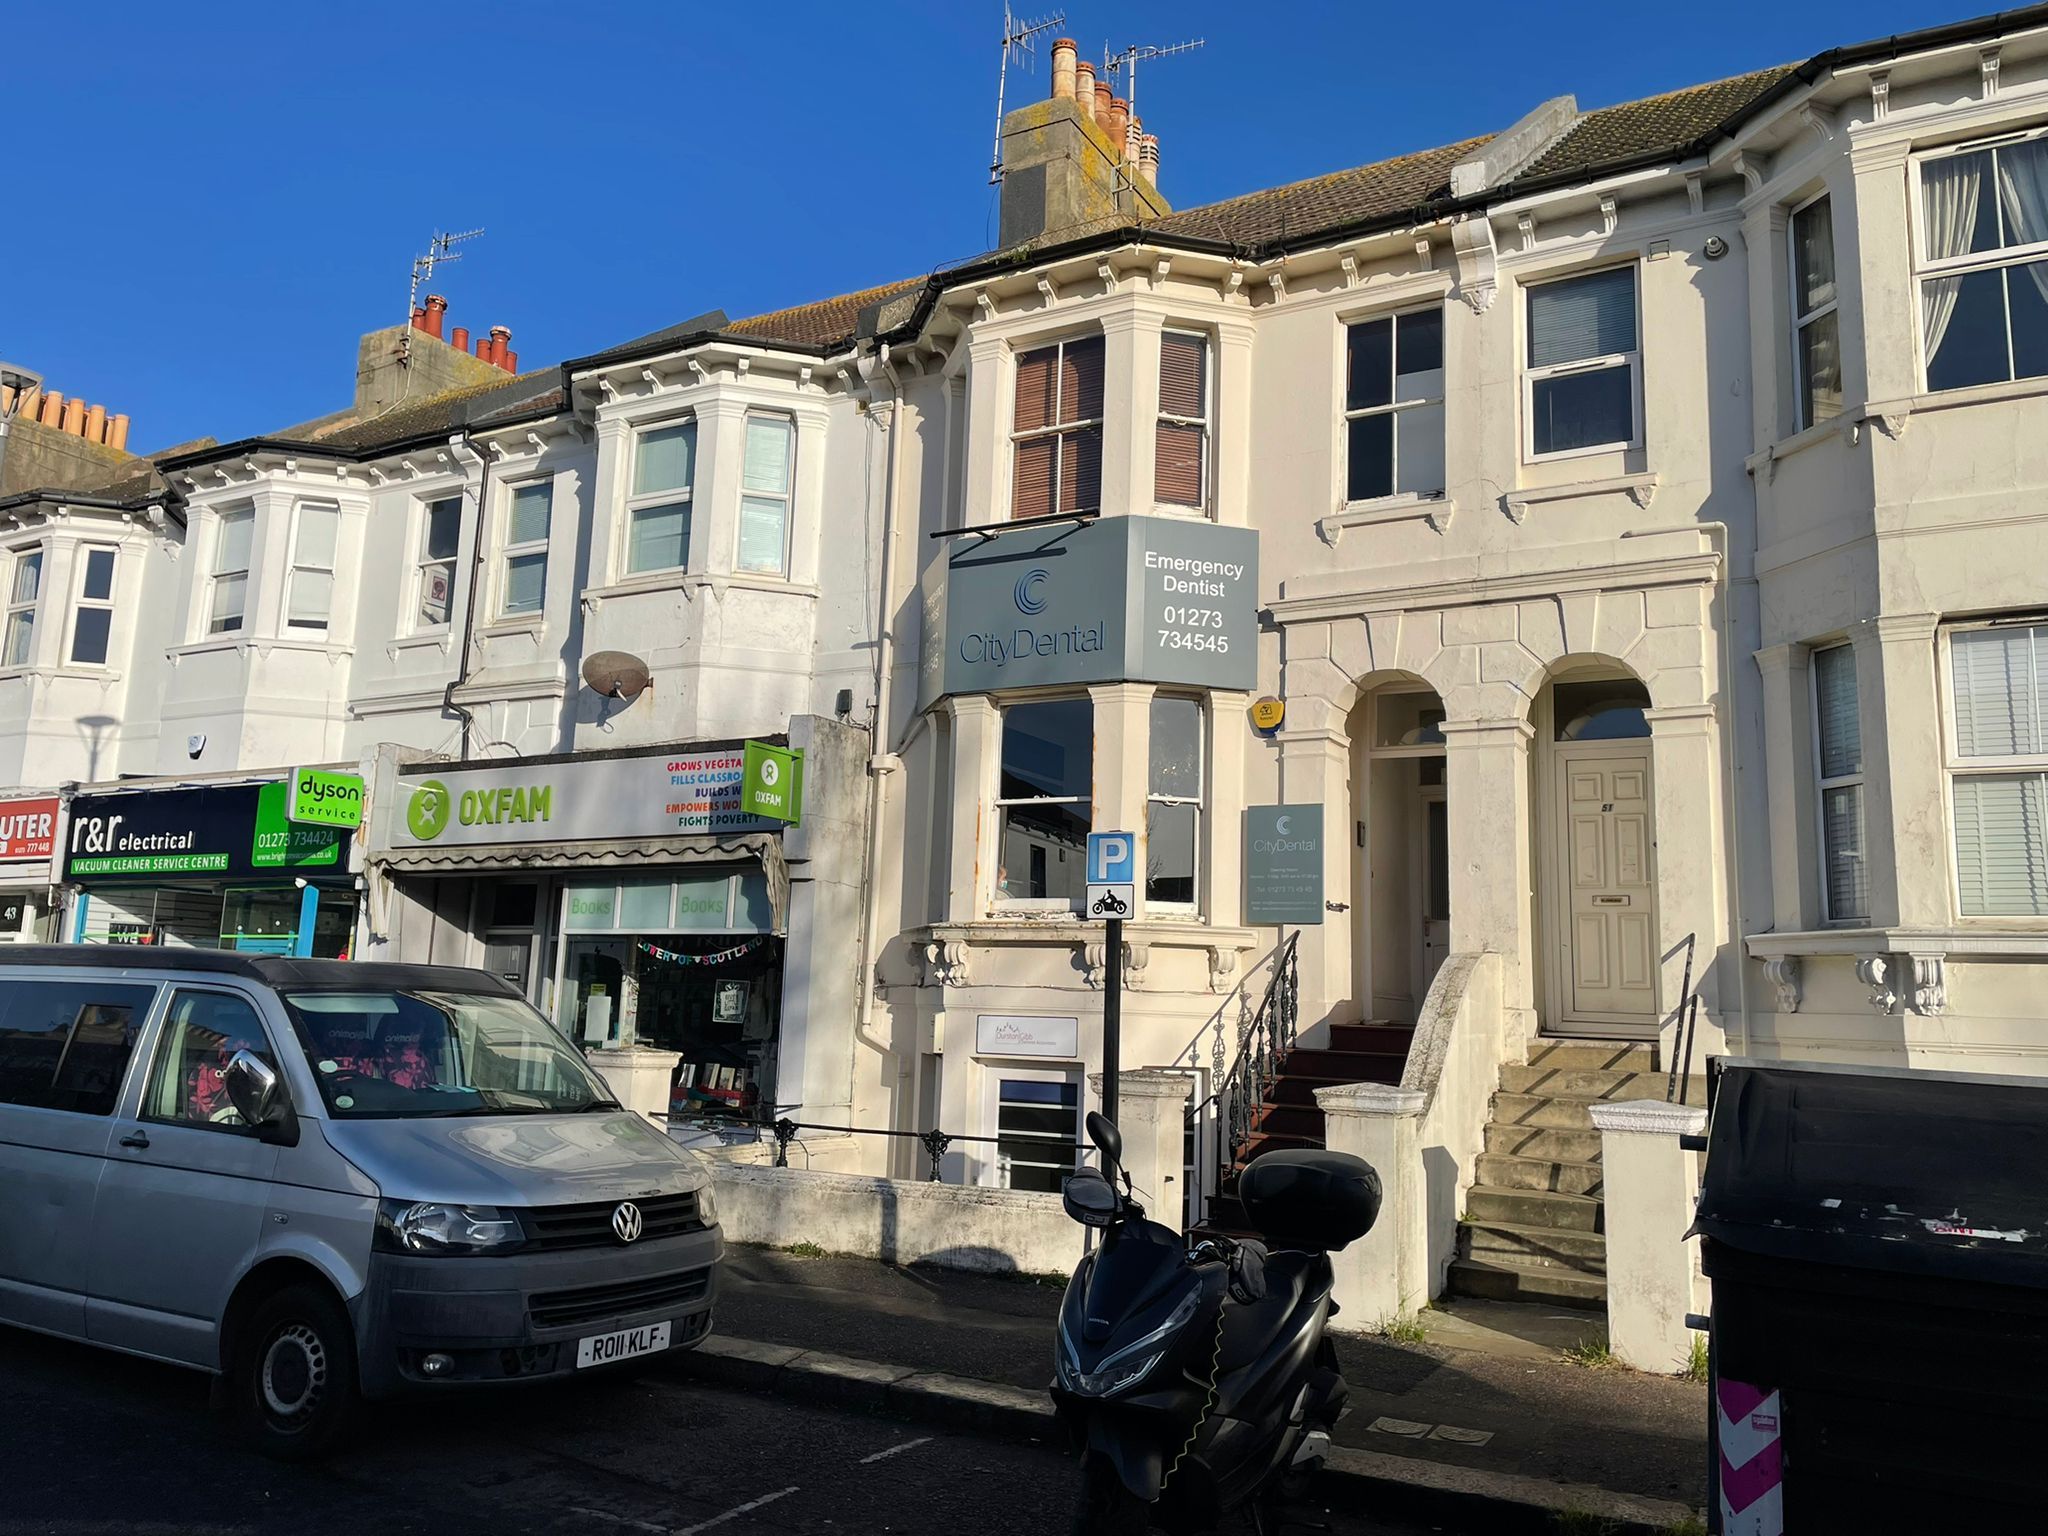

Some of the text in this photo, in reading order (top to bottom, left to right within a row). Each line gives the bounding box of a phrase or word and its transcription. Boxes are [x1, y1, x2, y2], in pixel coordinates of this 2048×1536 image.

[1145, 551, 1244, 581] Emergency
[1163, 575, 1225, 597] Dentist
[1164, 606, 1223, 628] 01273
[960, 620, 1105, 667] CityDental
[1158, 630, 1229, 653] 734545
[667, 760, 702, 772] GROWS
[671, 772, 744, 785] FILLS CLASSRO
[300, 776, 359, 802] dyson
[695, 787, 729, 798] BUILDS
[755, 791, 782, 807] OXFAM
[300, 806, 356, 819] service
[459, 785, 552, 826] OXFAM
[666, 801, 742, 814] EMPOWERS WO
[679, 814, 760, 827] FIGHTS POVERTY
[72, 815, 193, 853] r&r electrical
[258, 831, 334, 848] 01273 734424
[1253, 839, 1316, 855] CityDental
[74, 856, 226, 871] VACUUM CLEANER SERVICE CENTRE
[1098, 837, 1128, 879] P
[571, 896, 723, 914] Books Books
[678, 955, 693, 965] OF
[703, 935, 764, 965] SCOTLAND
[592, 1327, 660, 1361] RO11 KLF
